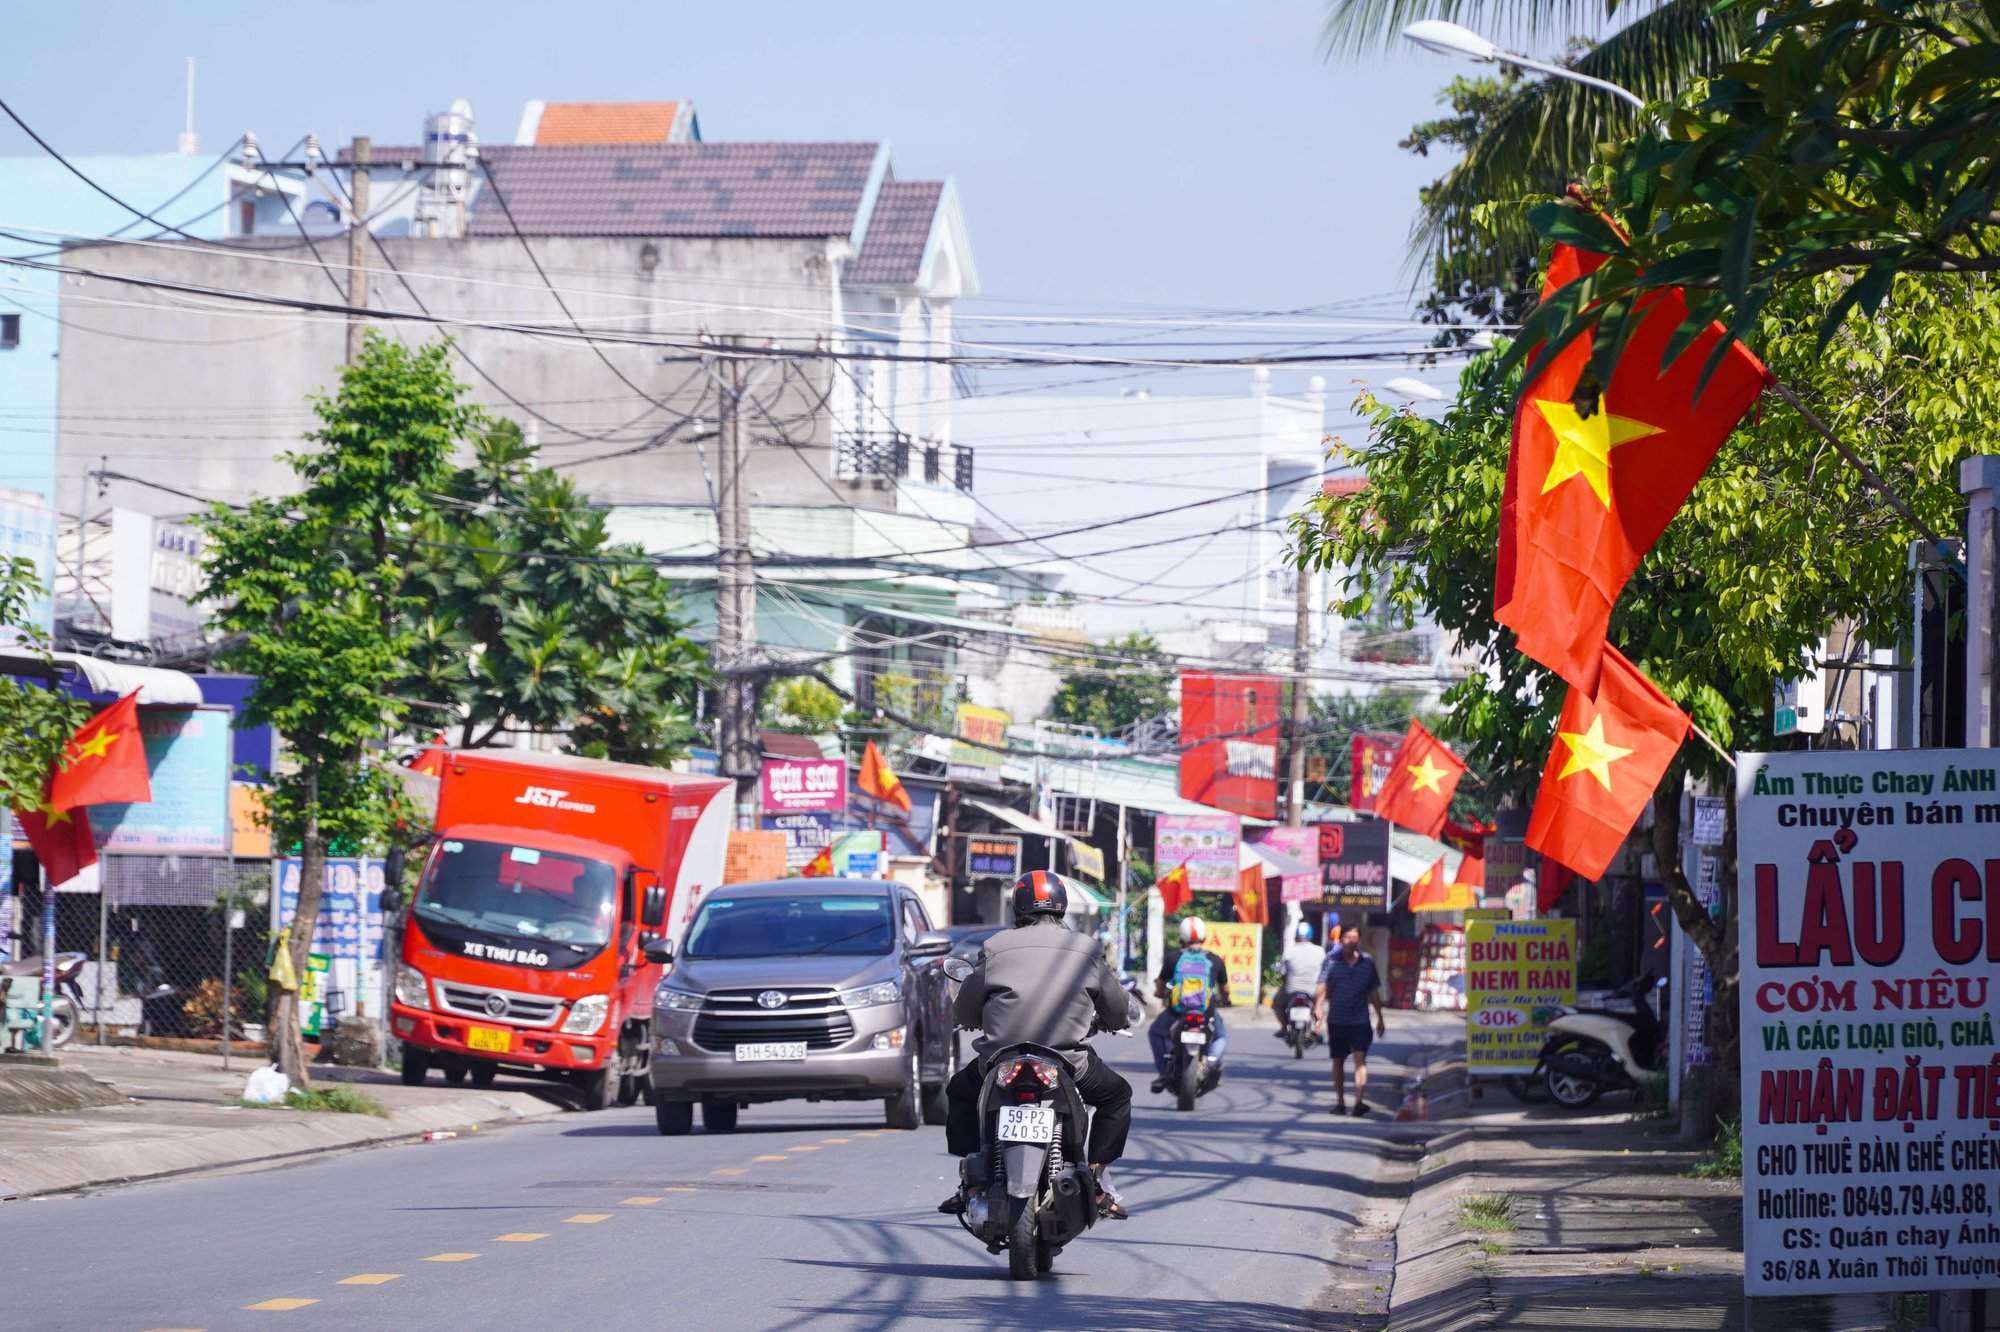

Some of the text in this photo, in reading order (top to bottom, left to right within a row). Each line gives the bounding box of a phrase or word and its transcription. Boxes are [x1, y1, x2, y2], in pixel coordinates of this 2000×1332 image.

[769, 762, 839, 792] NÓN SƠN
[1753, 764, 1996, 799] Ẩm Thực Chay ÁNH
[514, 786, 596, 813] J&T EXPRESS
[1778, 802, 1895, 829] Chuyên
[1906, 800, 1963, 825] bán
[1755, 829, 1905, 968] LẨU
[463, 941, 484, 957] XE
[485, 945, 517, 962] THƯ
[516, 949, 549, 967] BÁO
[1471, 934, 1570, 961] BÚN CHẢ
[1471, 965, 1571, 990] NEM RÁN
[1756, 969, 1989, 1013] CƠM NIÊU
[1480, 1010, 1518, 1026] 30k
[1762, 1012, 1995, 1054] VÀ CÁC LOẠI GIÒ, CHẢ
[1758, 1057, 1864, 1135] NHẬN
[1873, 1055, 1945, 1133] ĐẶT
[1002, 1125, 1048, 1139] 240.55
[1757, 1144, 1797, 1176] CHO
[1803, 1137, 1852, 1174] THUÊ
[1859, 1136, 1900, 1173] BÀN
[1907, 1130, 1946, 1172] GHẾ
[1758, 1183, 1992, 1219] Hotline: 0849.79.49.88,
[1783, 1218, 2000, 1250] CS: Quán chay Ánh
[1762, 1258, 1821, 1283] 36/8A
[1828, 1258, 1877, 1279] Xuân
[1886, 1255, 1928, 1278] Thới
